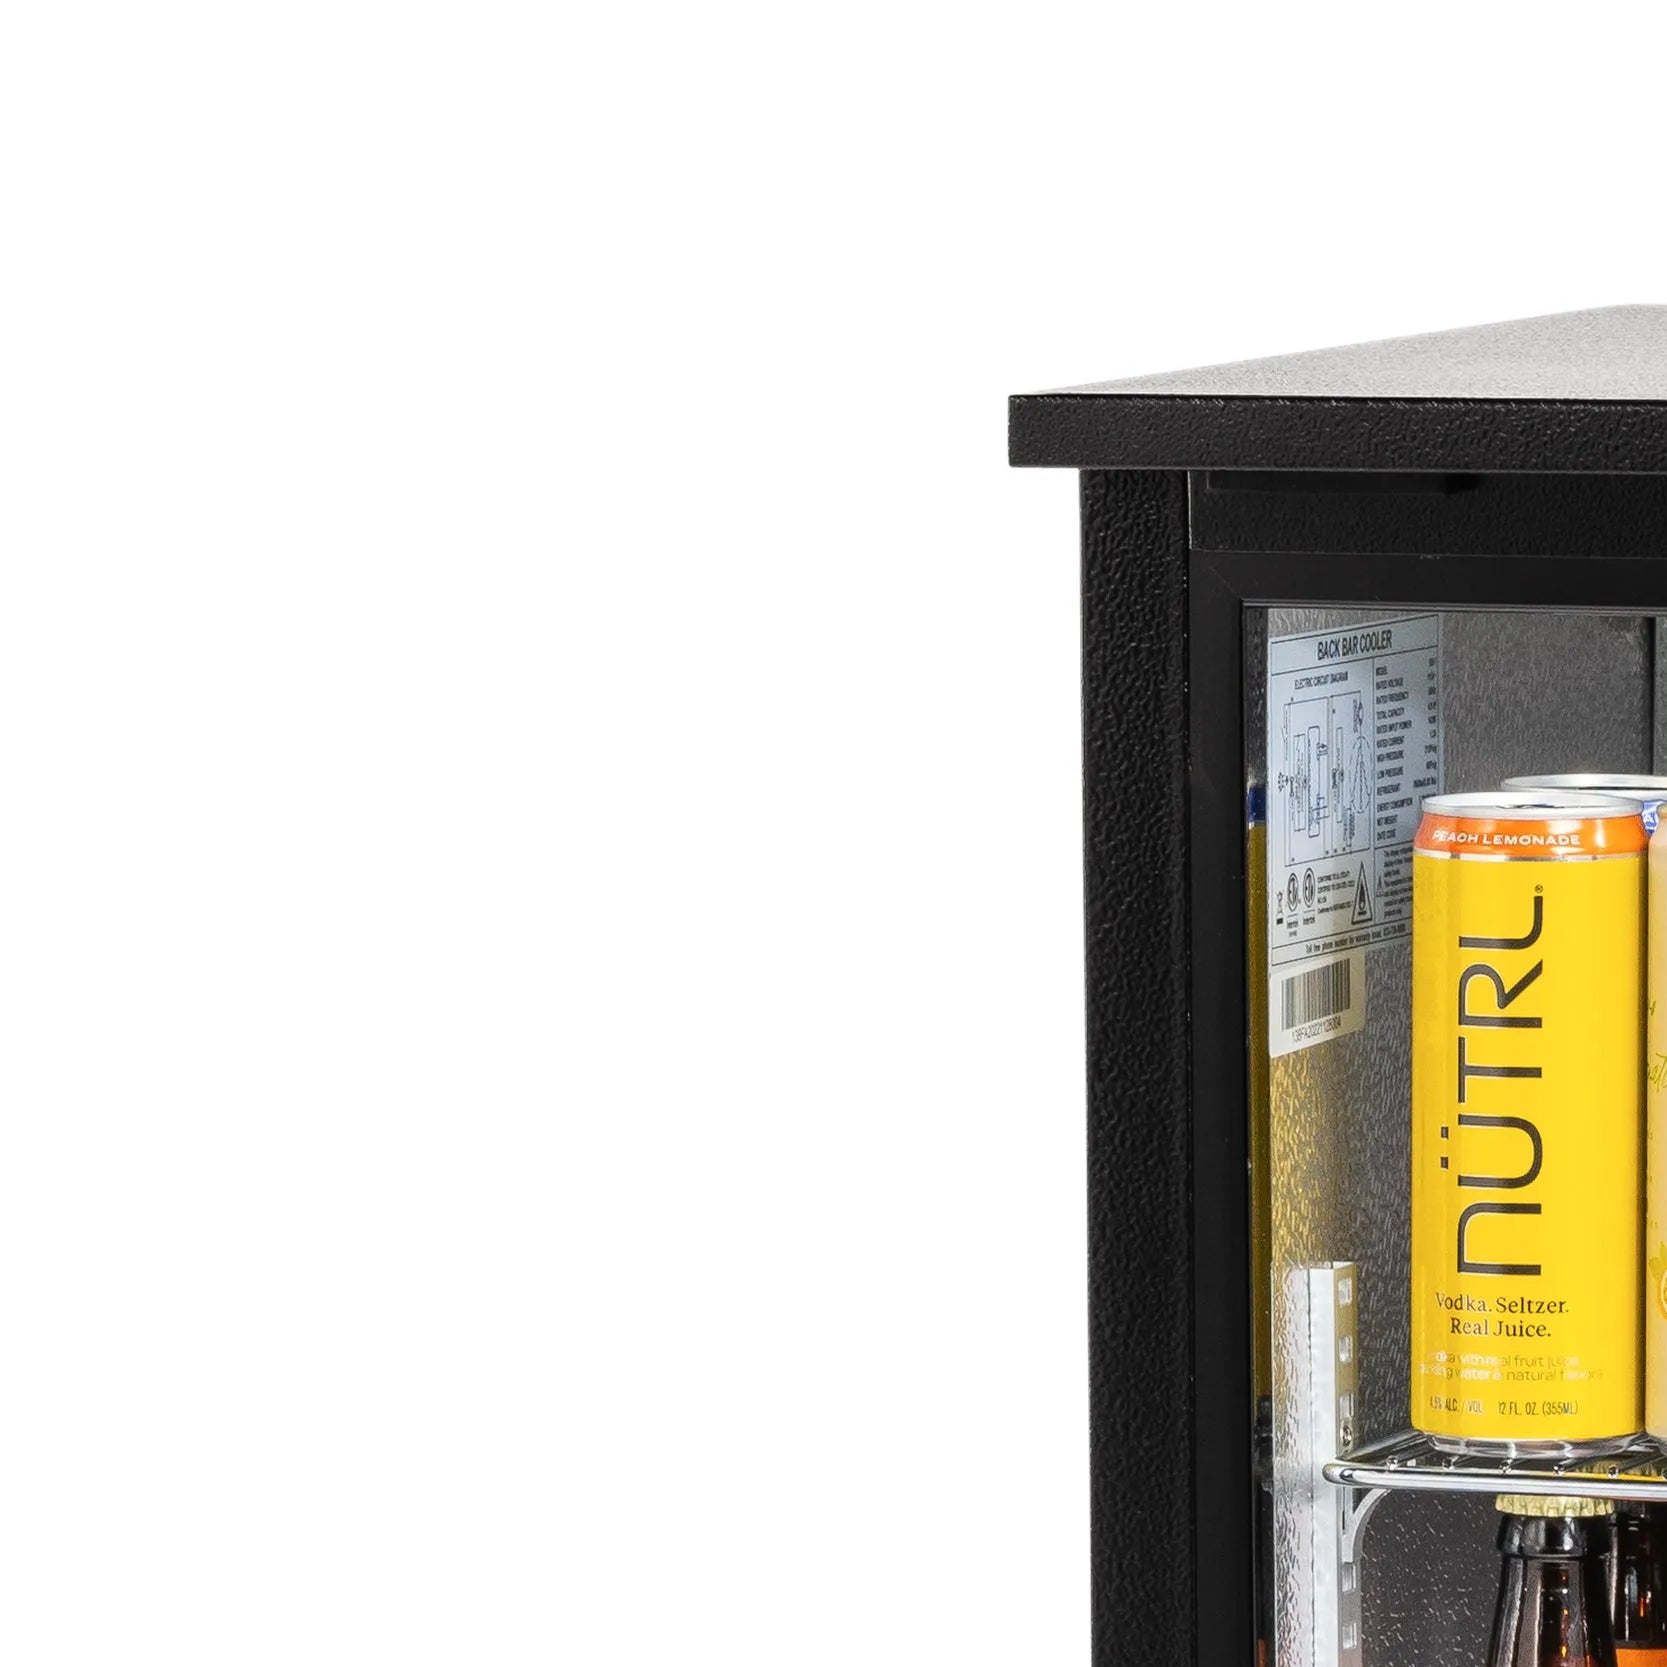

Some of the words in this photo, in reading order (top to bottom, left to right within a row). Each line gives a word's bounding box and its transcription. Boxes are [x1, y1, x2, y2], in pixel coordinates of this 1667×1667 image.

[1317, 638, 1341, 660] BACK
[1342, 634, 1359, 656] BAR
[1359, 629, 1393, 653] COOLER
[1432, 829, 1478, 843] PEACH
[1482, 832, 1581, 846] LEMONADE
[1435, 1292, 1493, 1313] Vodka.
[1495, 1296, 1569, 1315] Seltzer.
[1450, 1317, 1488, 1336] Real
[1492, 1321, 1552, 1338] Juice.
[1498, 1400, 1506, 1415] 12
[1542, 1400, 1578, 1416] (355ML)
